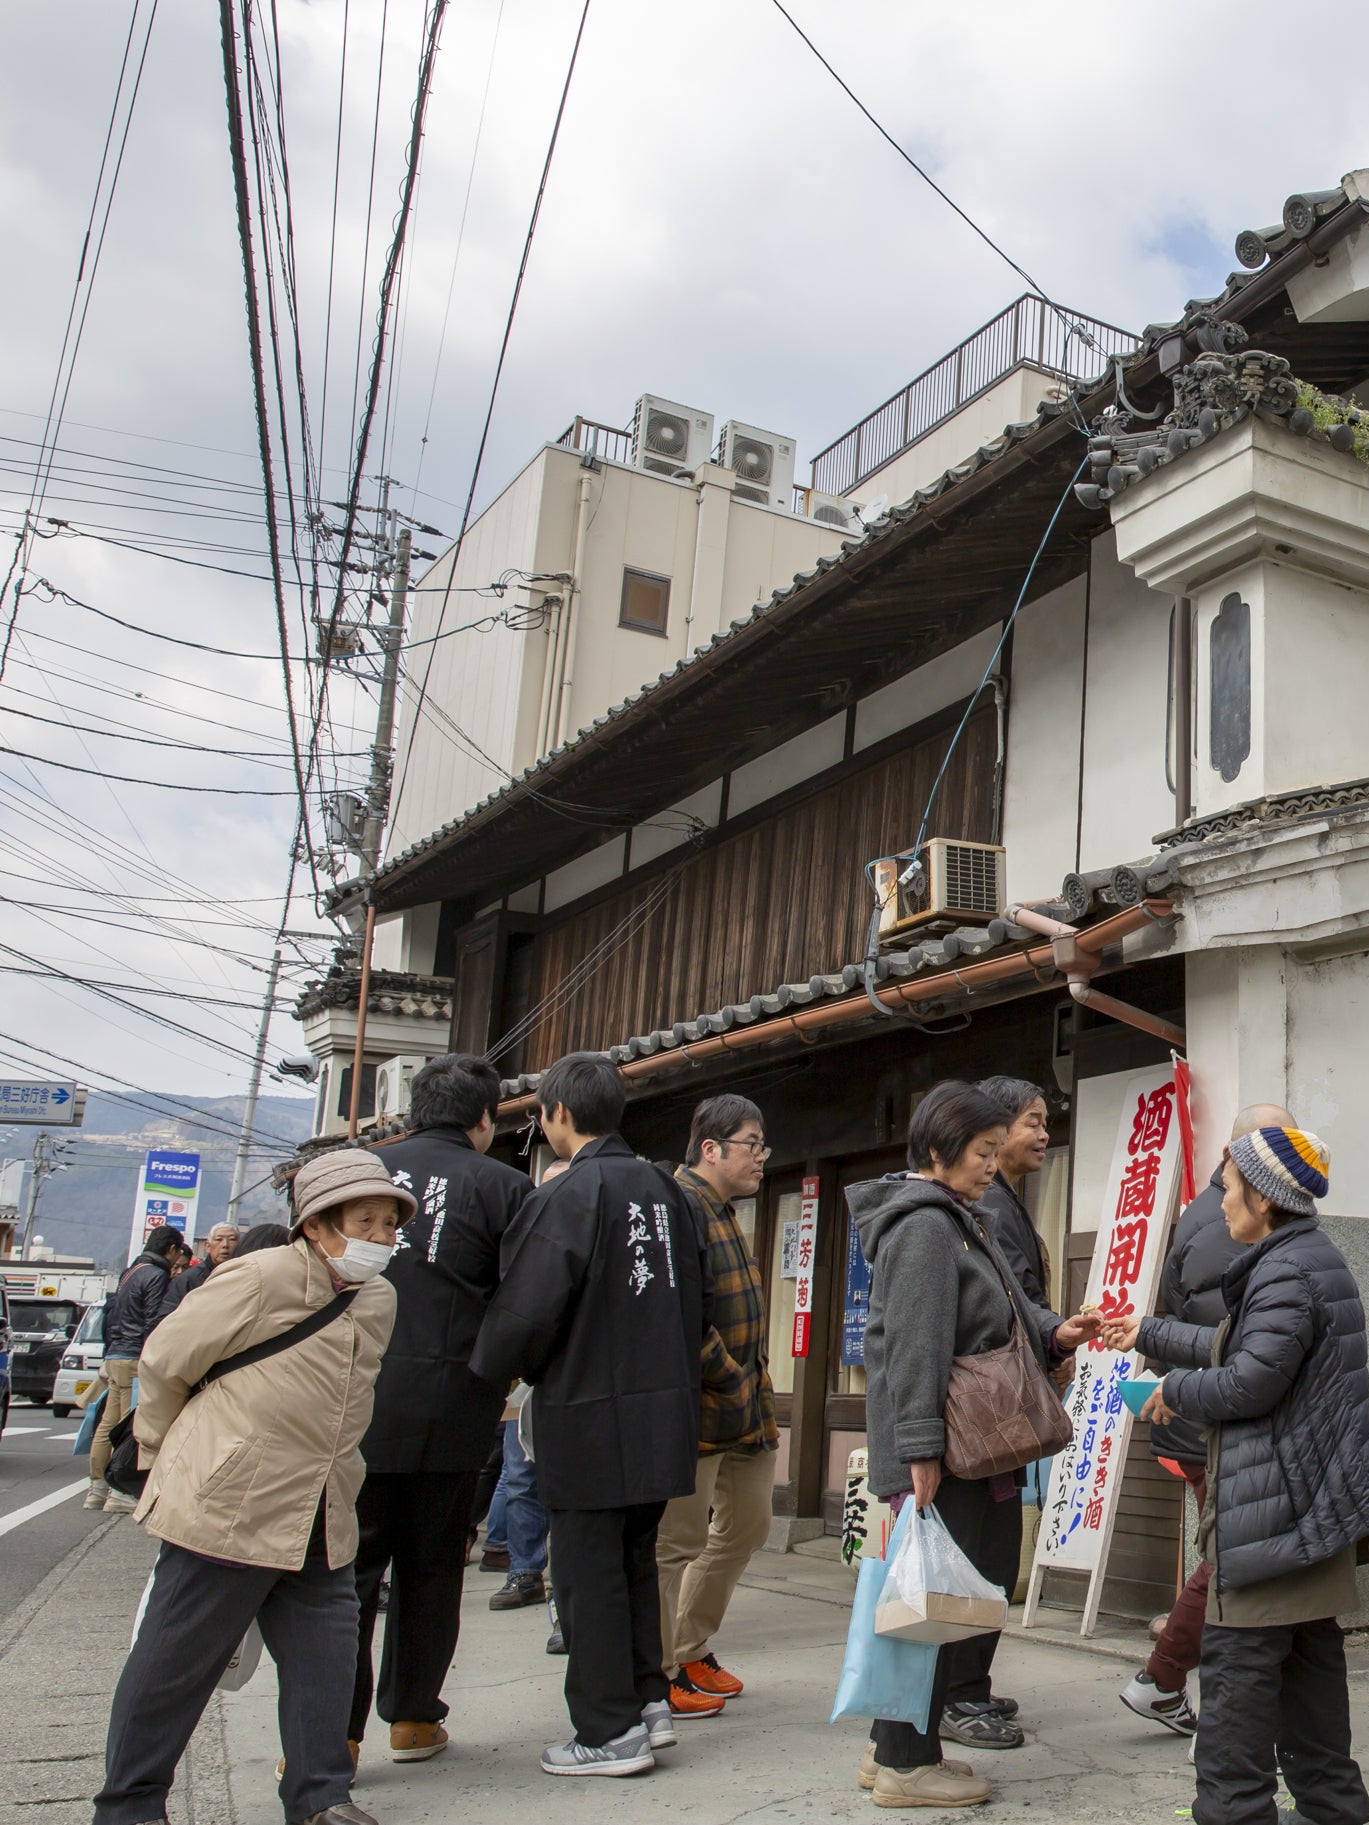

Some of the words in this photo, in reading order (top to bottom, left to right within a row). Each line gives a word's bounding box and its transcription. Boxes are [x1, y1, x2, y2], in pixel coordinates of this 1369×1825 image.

[0, 1085, 50, 1104] 局三好庁舎
[151, 1161, 196, 1174] Frespo
[627, 1201, 655, 1296] 大地の夢
[797, 1203, 814, 1308] 三芳菊
